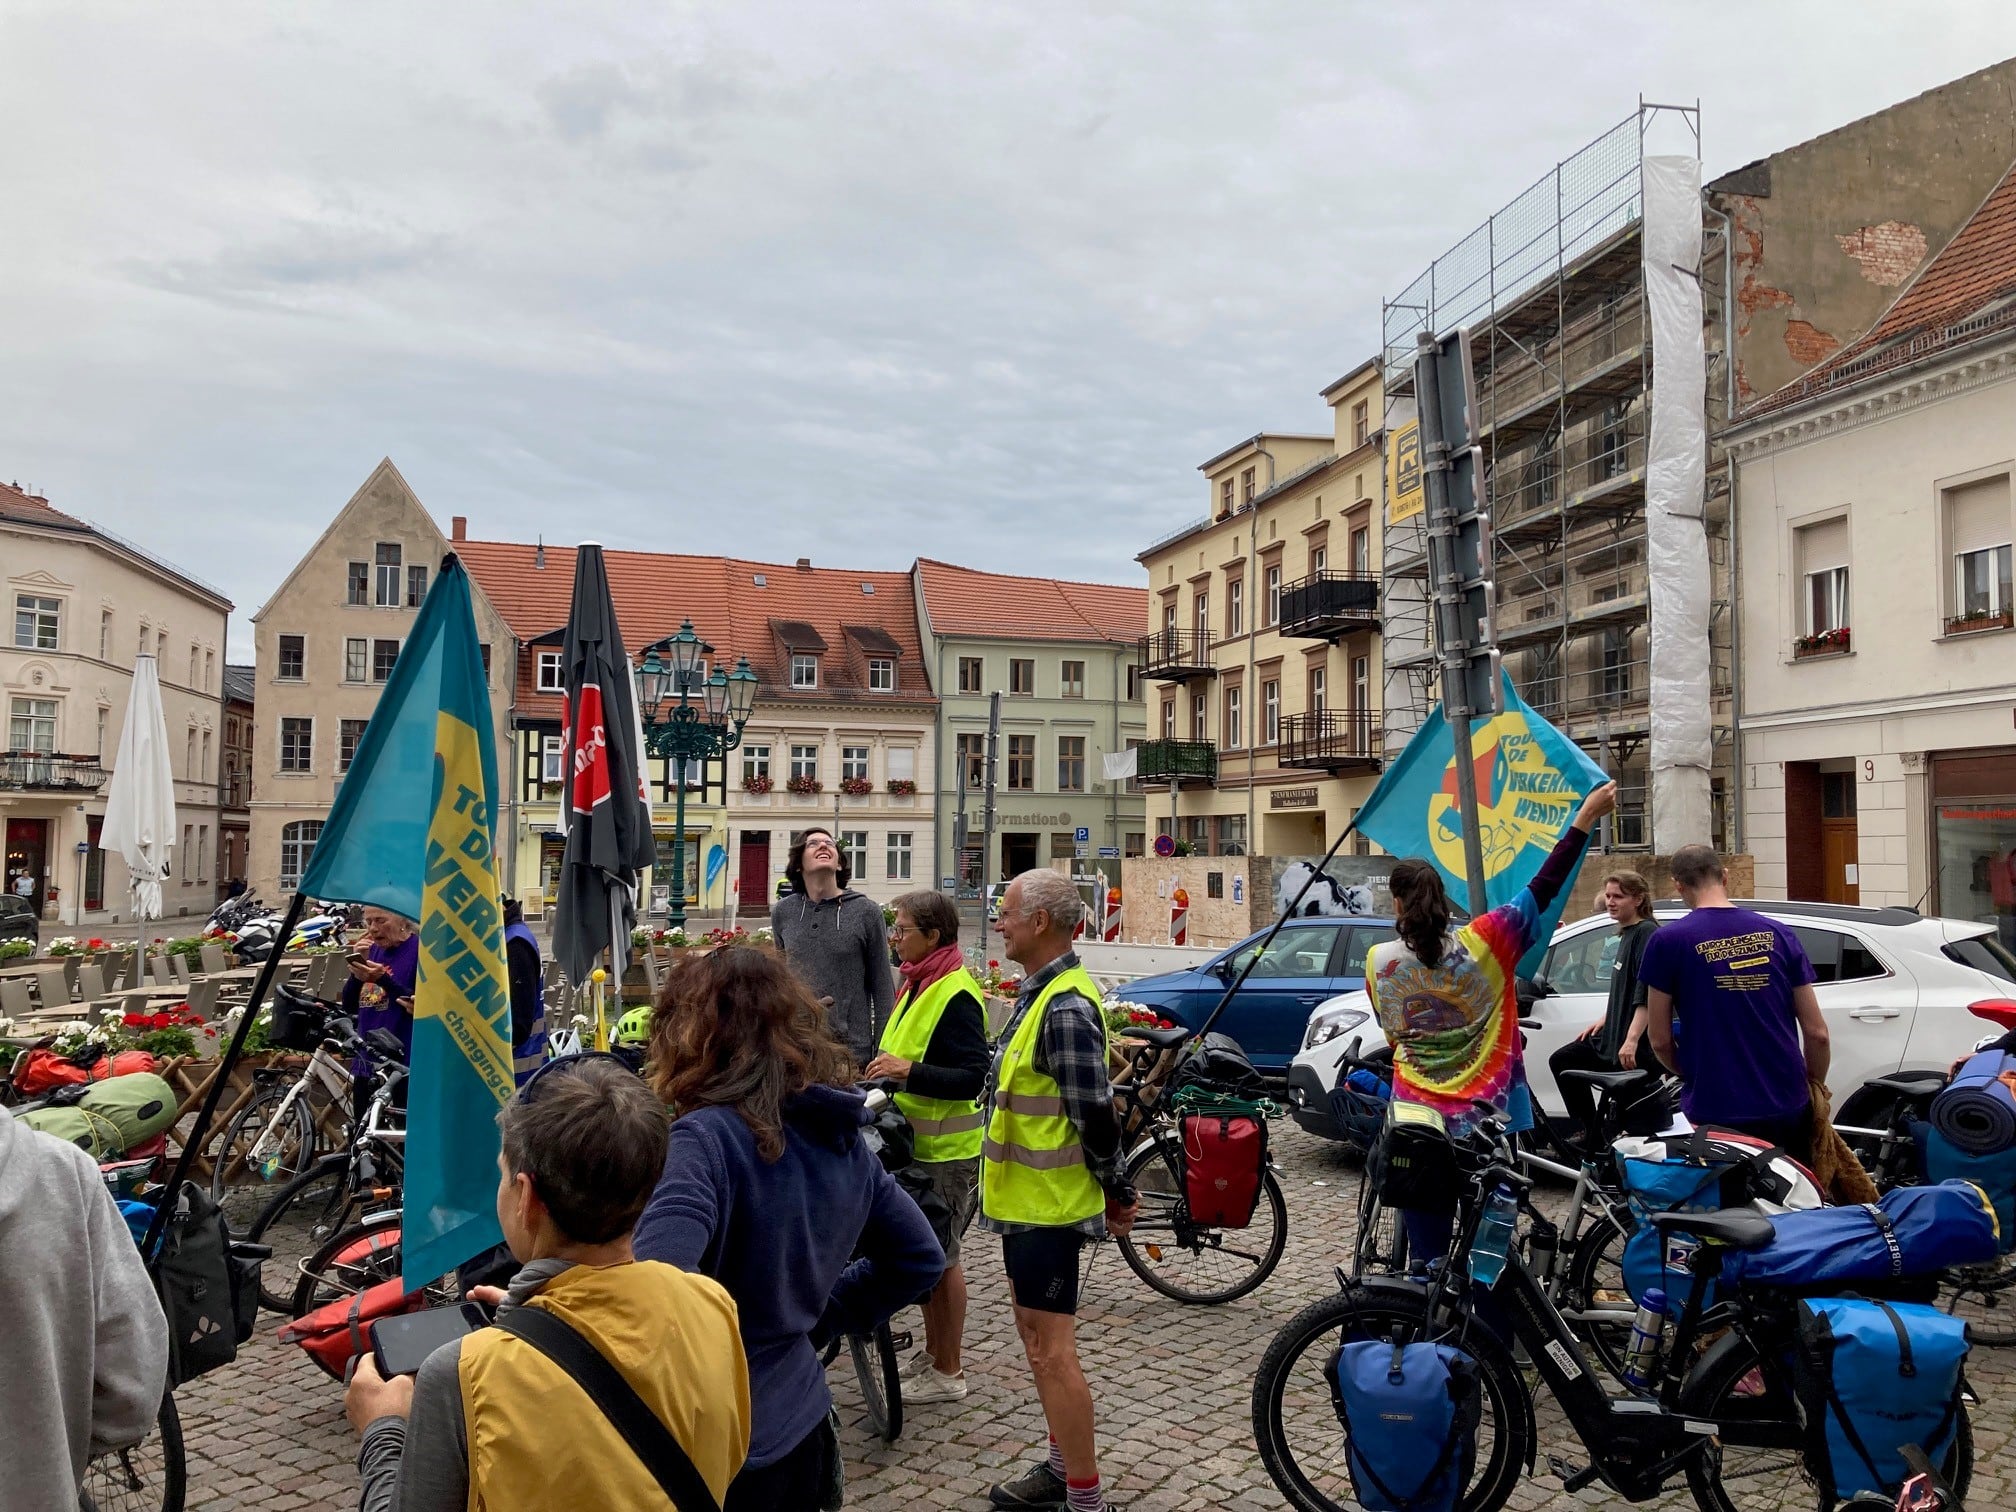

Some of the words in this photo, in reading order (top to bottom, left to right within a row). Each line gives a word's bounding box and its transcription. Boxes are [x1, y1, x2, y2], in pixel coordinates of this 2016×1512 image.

[1509, 749, 1529, 763] DE
[1864, 759, 1874, 781] 9
[1514, 797, 1568, 828] WENDE
[1078, 828, 1086, 840] P
[445, 1010, 504, 1089] changing
[1552, 1351, 1574, 1377] WENIGER
[1560, 1352, 1574, 1368] AUTO
